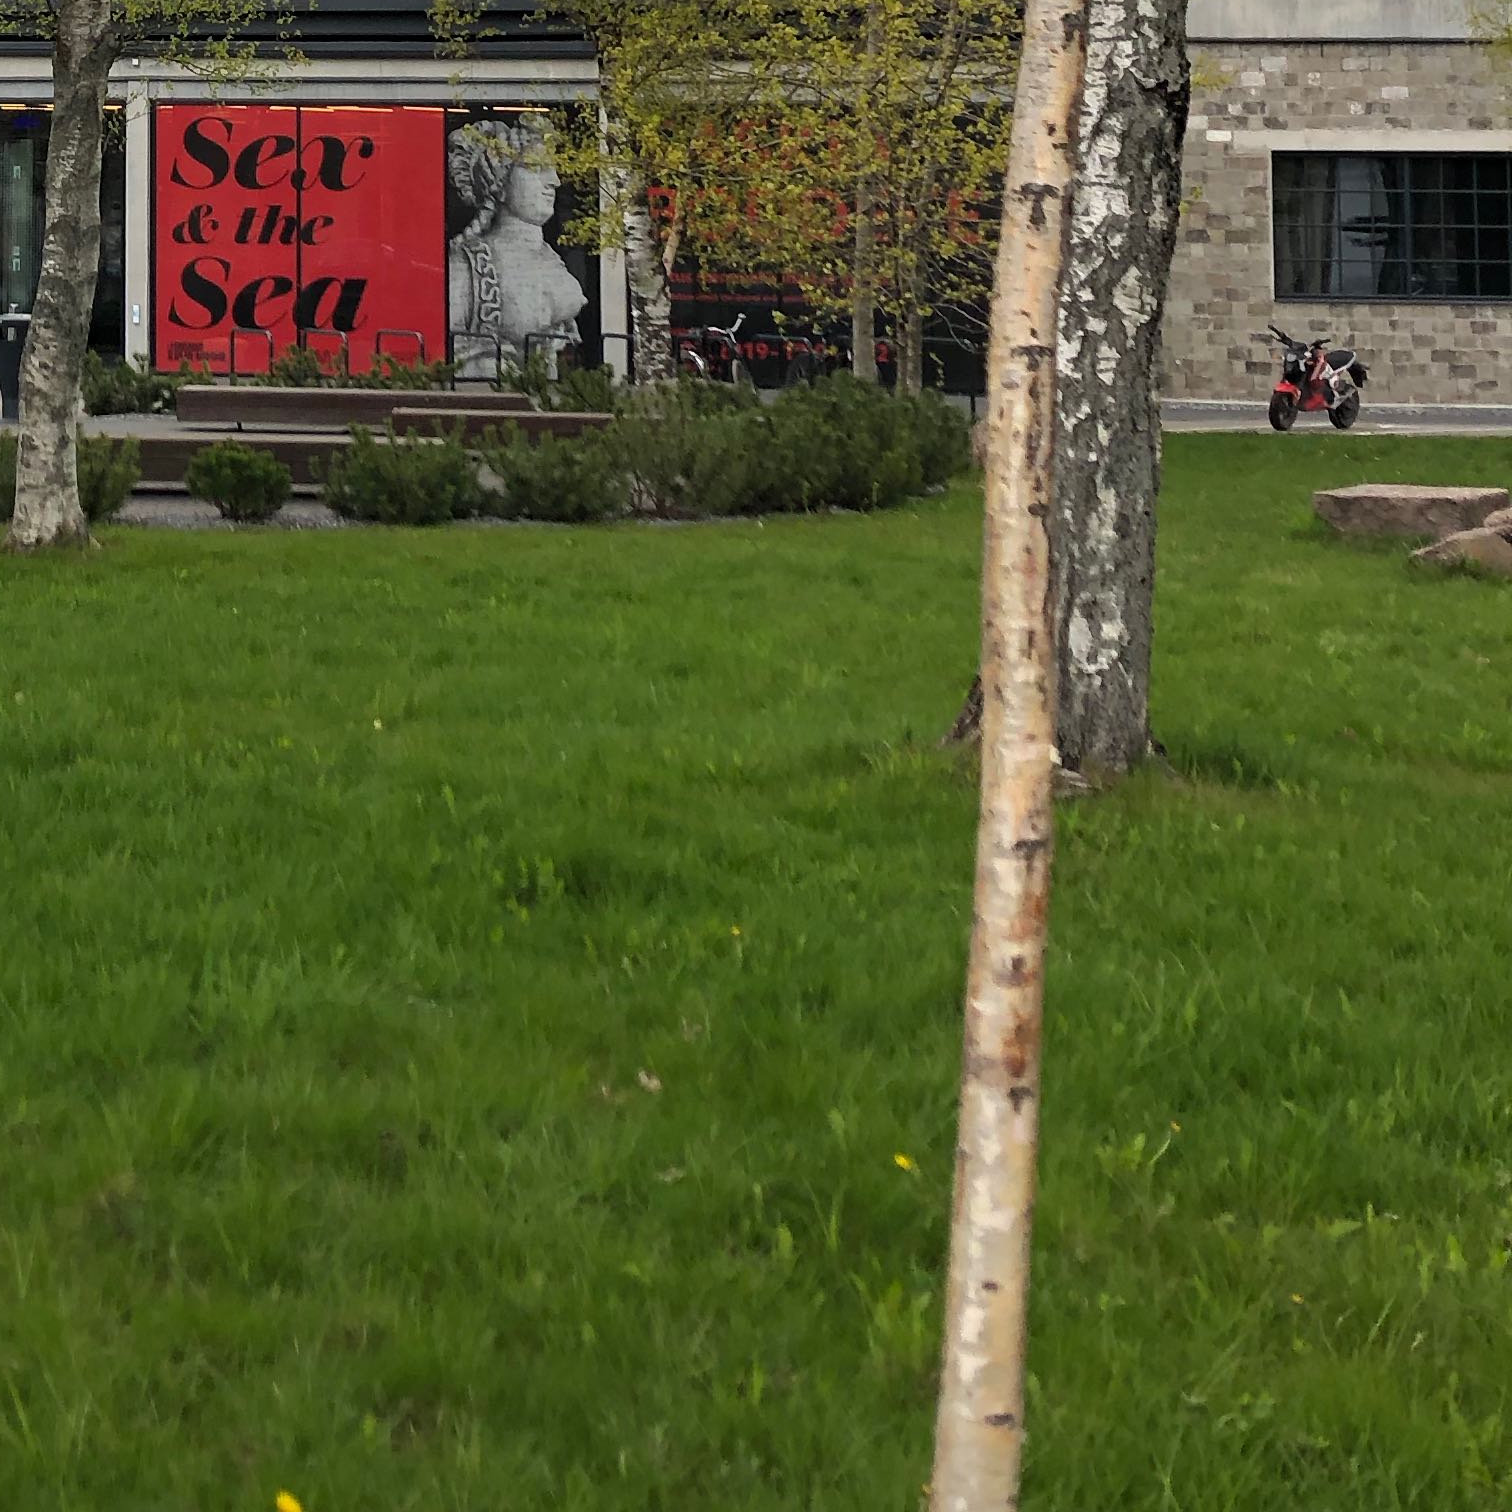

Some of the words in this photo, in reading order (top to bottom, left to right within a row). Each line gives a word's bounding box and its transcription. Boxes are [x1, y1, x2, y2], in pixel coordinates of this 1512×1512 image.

[170, 116, 374, 192] Sex
[172, 204, 219, 244] &
[234, 205, 334, 245] the
[168, 256, 369, 332] Sea
